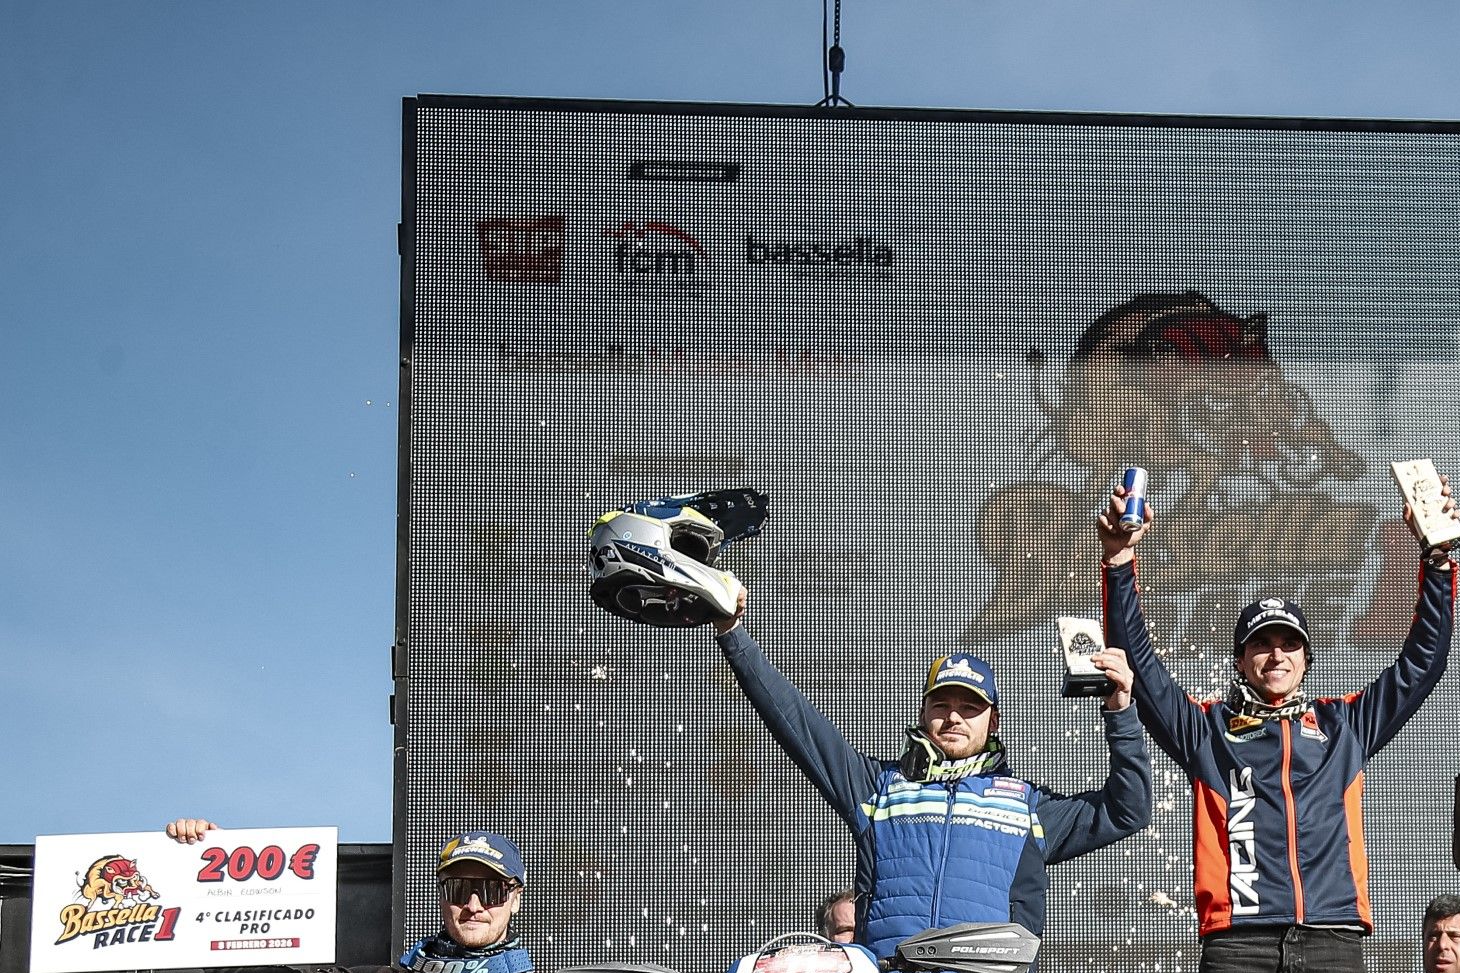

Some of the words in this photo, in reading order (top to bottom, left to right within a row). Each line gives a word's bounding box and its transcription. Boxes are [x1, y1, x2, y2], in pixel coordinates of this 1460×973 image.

[745, 231, 895, 268] bassella
[498, 341, 645, 374] bassella
[967, 818, 1028, 838] FACTORY
[53, 902, 163, 946] Bassella
[214, 908, 316, 923] CLASIFICADO
[92, 923, 156, 950] RACE
[153, 906, 182, 942] 1
[239, 922, 271, 934] PRO
[225, 940, 268, 950] FEBRERO
[268, 939, 294, 949] 2026
[950, 945, 1021, 956] POLISPORT
